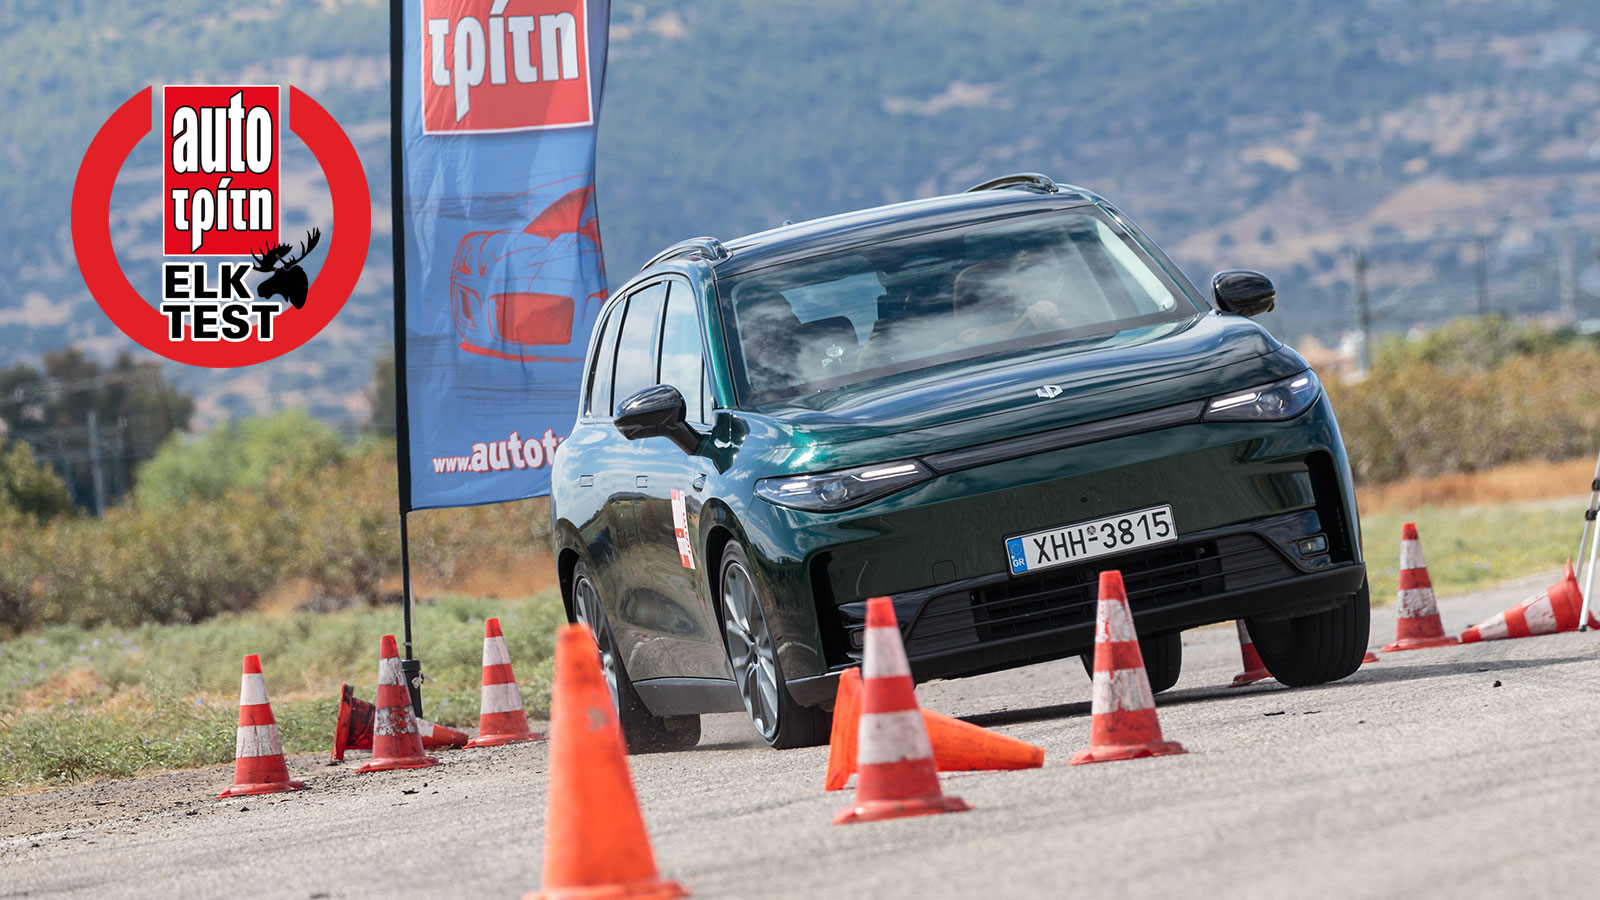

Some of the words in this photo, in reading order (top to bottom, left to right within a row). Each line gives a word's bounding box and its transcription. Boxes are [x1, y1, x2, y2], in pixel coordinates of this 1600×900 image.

[432, 428, 564, 473] www.autot
[1032, 510, 1170, 564] XHH-3815
[1012, 557, 1025, 567] GR
